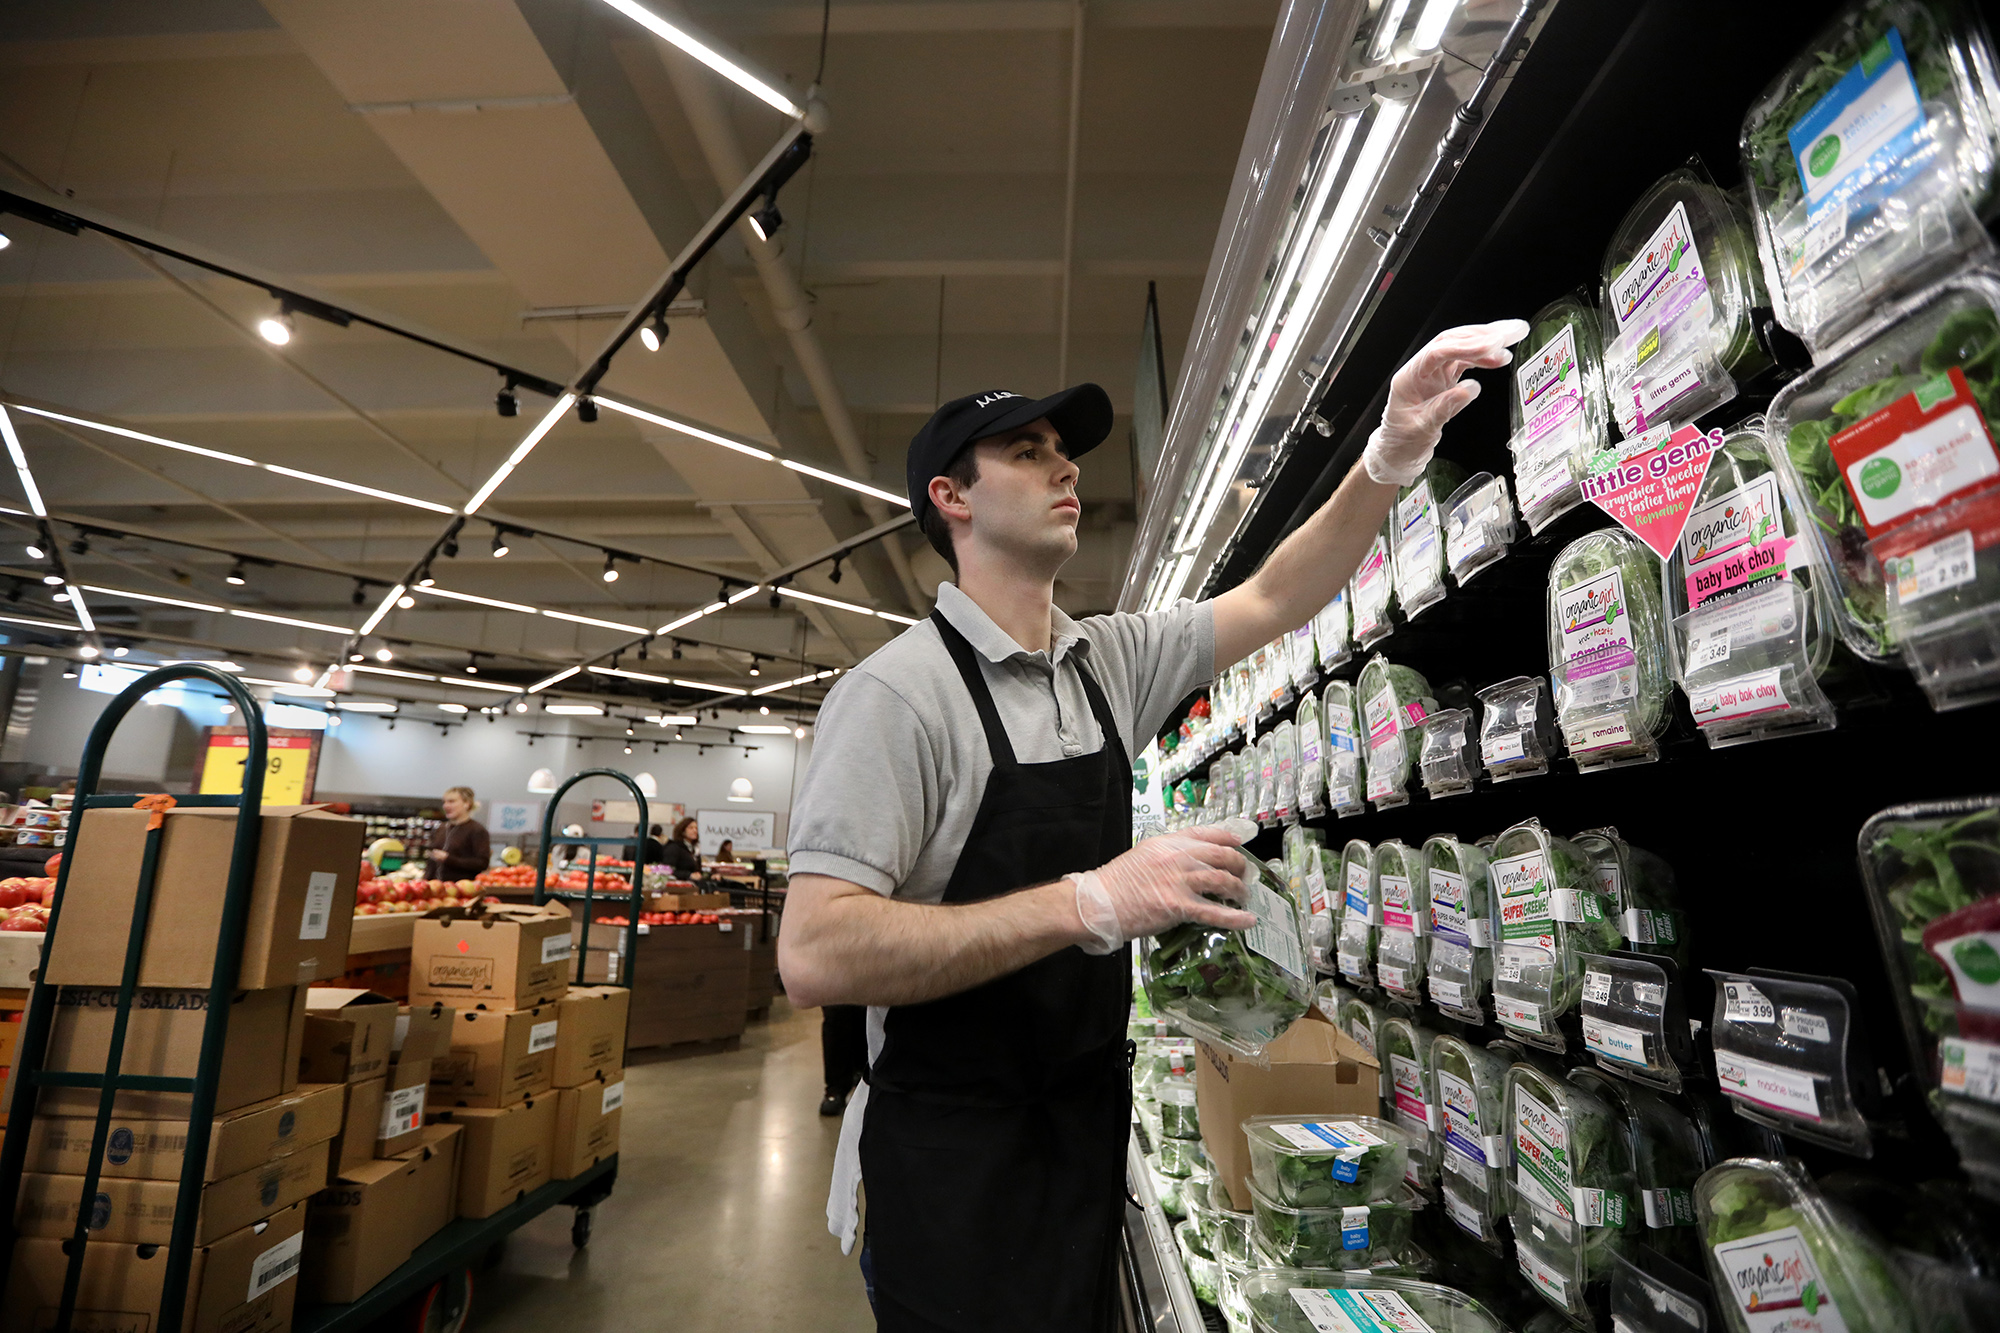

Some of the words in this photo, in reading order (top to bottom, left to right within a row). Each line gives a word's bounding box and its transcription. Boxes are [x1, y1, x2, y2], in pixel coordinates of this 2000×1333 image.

[1622, 224, 1681, 304] organicgirl
[1655, 273, 1679, 298] hearts
[1637, 337, 1659, 363] new
[1525, 341, 1569, 391] organicgirl
[1649, 383, 1668, 401] little
[1668, 368, 1692, 388] gems
[1621, 428, 1666, 457] organicgirl
[1581, 465, 1642, 500] little
[1650, 428, 1723, 477] gems
[1593, 450, 1616, 473] NEW
[1540, 468, 1566, 489] romaine
[1661, 462, 1706, 489] sweeter
[1619, 505, 1627, 518] &
[1628, 494, 1664, 516] tastier
[1665, 482, 1695, 502] than
[1634, 501, 1686, 527] Romaine
[1690, 493, 1767, 550] organicgirl
[1695, 570, 1722, 593] baby
[1724, 560, 1747, 581] bok
[1748, 546, 1776, 571] choy
[1565, 581, 1617, 624] organicgirl
[1578, 633, 1591, 645] true
[1593, 627, 1614, 637] hearts
[1709, 644, 1727, 660] 3.49
[1719, 690, 1737, 707] baby
[1738, 687, 1754, 702] bok
[1756, 683, 1777, 699] choy
[1592, 724, 1625, 739] romaine
[1503, 862, 1543, 890] organicgirl
[1595, 990, 1608, 1002] 3.49
[1752, 1005, 1773, 1018] 3.99
[1797, 1024, 1815, 1036] ONLY
[1607, 1036, 1633, 1051] butter
[1521, 1103, 1565, 1150] organicgirl
[1606, 1197, 1615, 1221] SUPER
[1614, 1193, 1623, 1225] GREENS!
